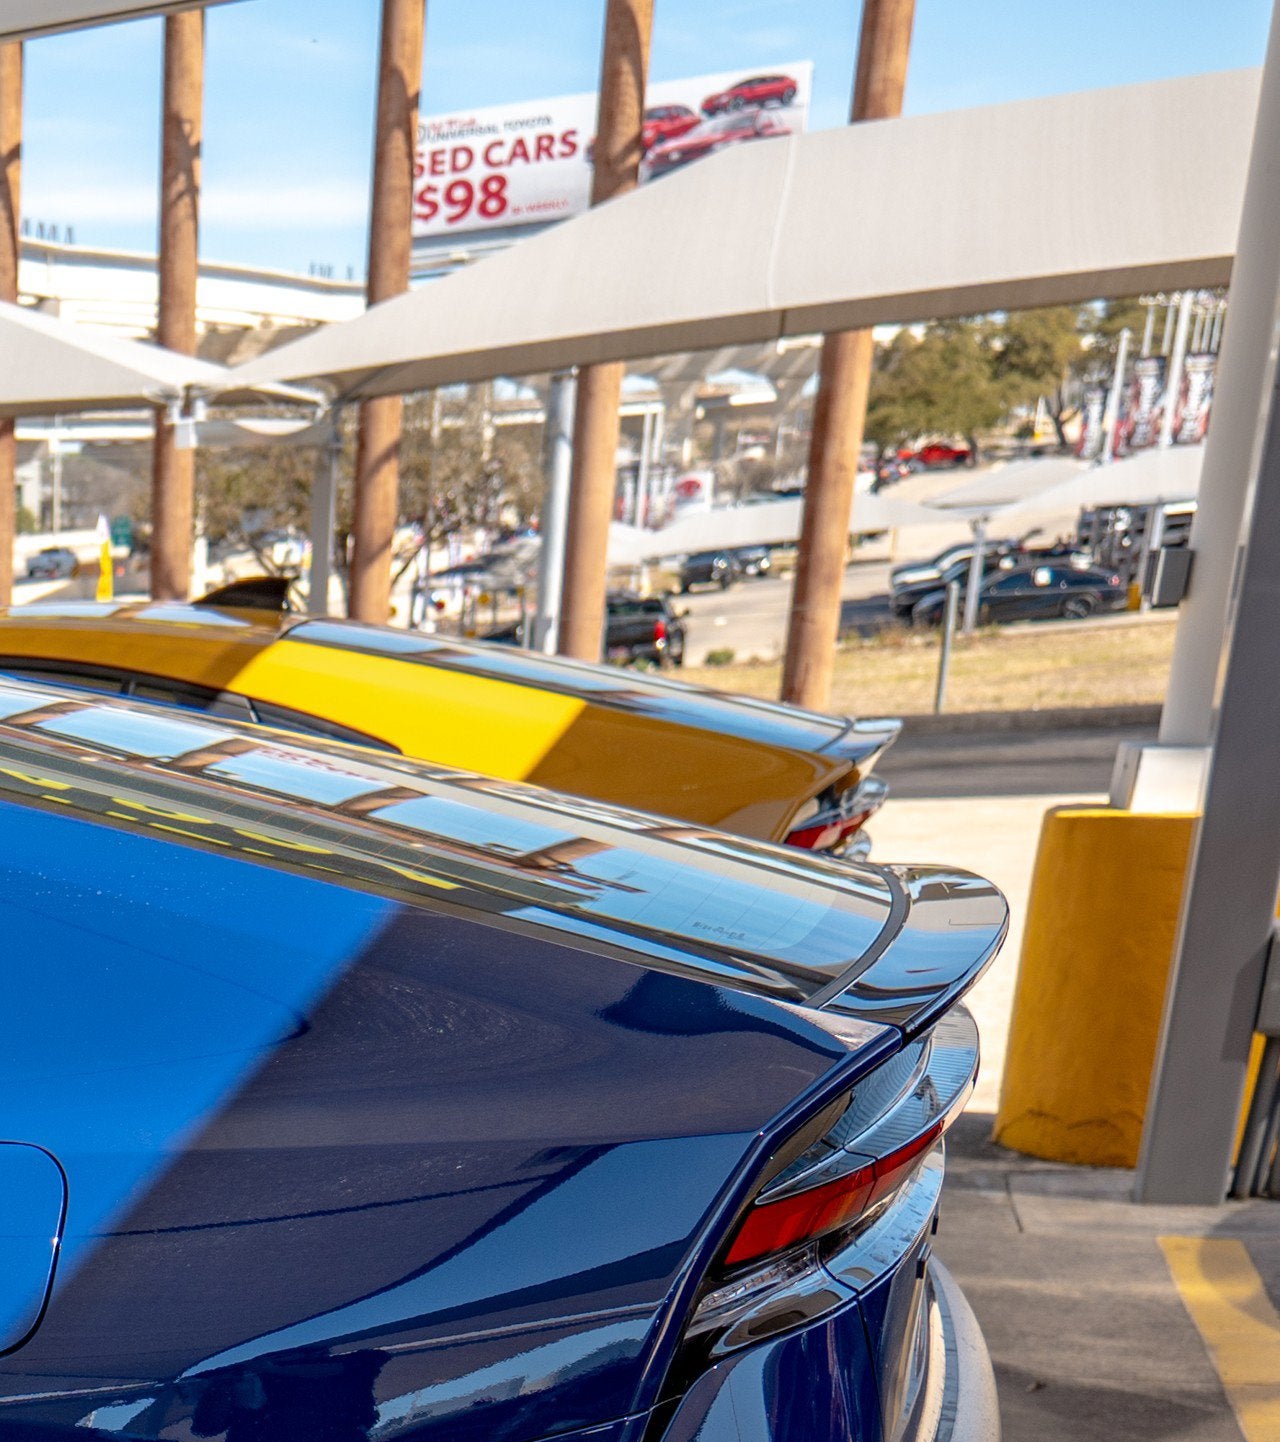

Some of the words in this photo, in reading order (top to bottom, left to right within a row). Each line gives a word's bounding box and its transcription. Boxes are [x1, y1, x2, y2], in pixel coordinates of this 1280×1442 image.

[414, 146, 474, 177] SED
[484, 130, 577, 167] CARS
[414, 175, 508, 223] $98
